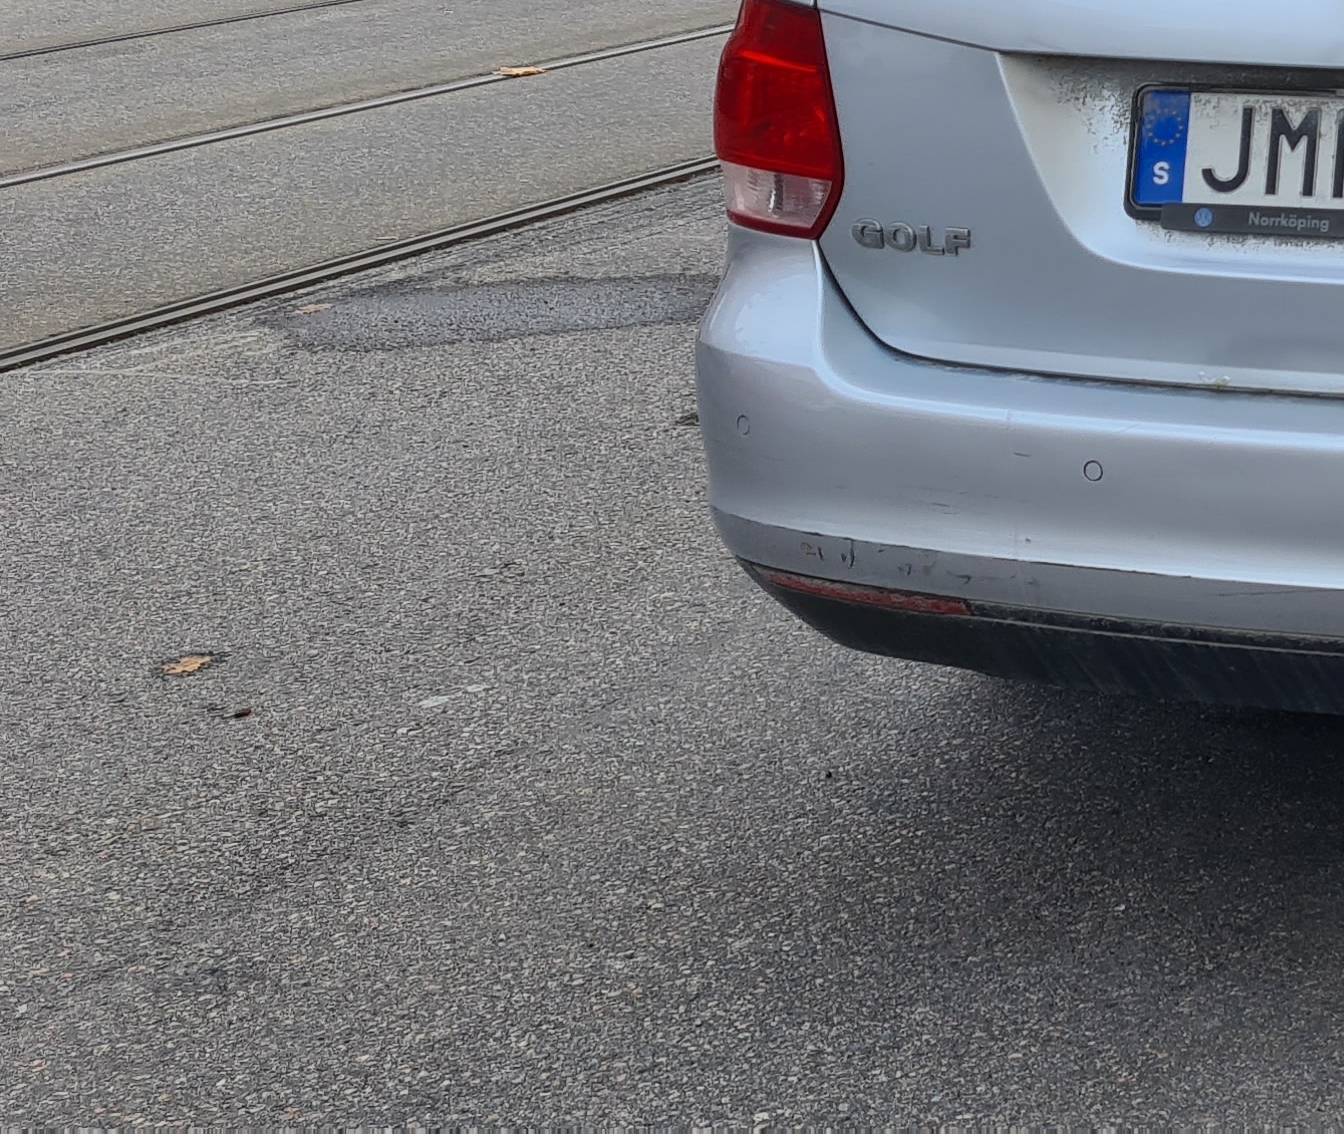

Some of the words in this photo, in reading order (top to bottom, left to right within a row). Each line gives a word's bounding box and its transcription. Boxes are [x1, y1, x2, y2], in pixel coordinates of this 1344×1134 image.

[1152, 161, 1170, 185] S
[1248, 211, 1330, 233] Norrköping
[851, 217, 972, 257] GOLF
